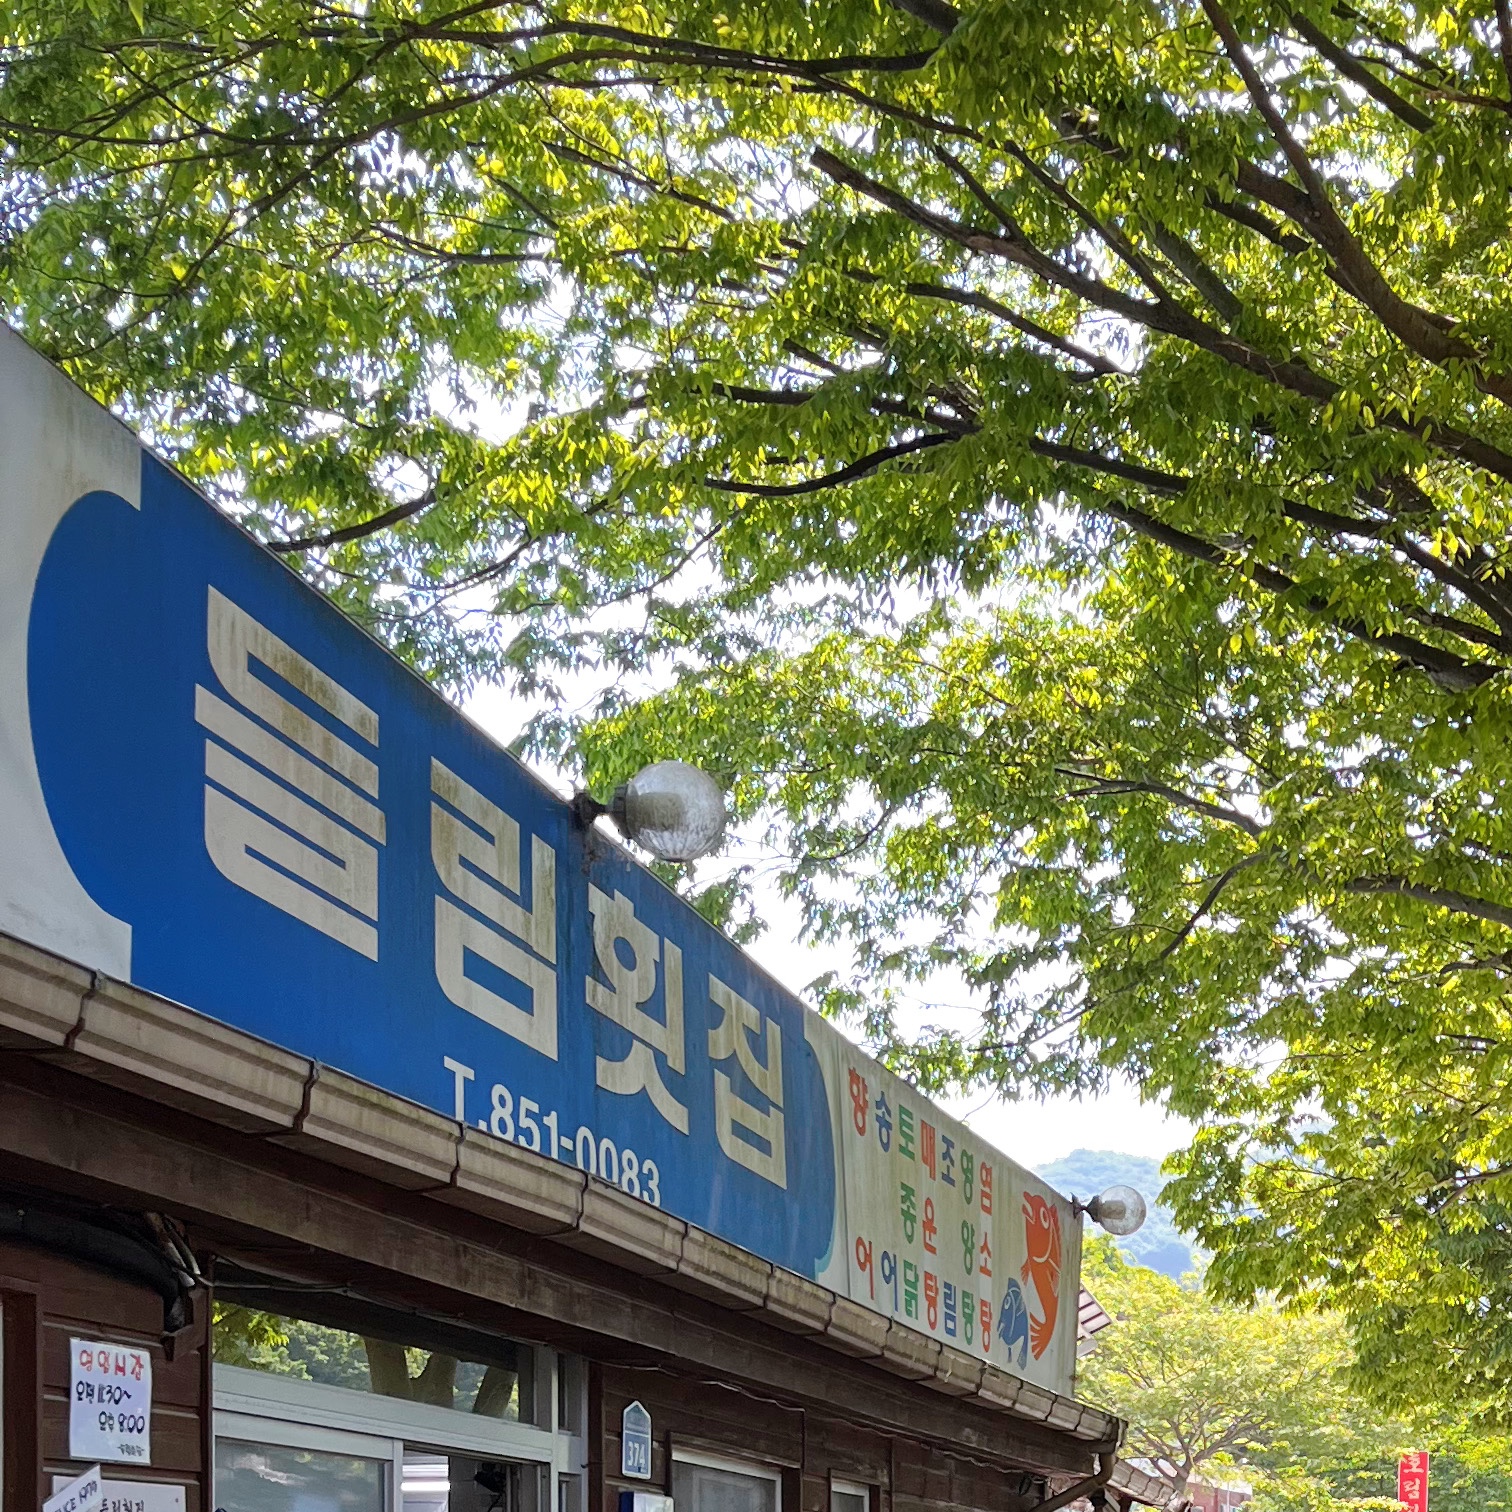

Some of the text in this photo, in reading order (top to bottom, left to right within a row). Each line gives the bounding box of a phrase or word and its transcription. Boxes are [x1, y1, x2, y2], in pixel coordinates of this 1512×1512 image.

[195, 583, 788, 1190] 들림횟집
[443, 1055, 661, 1208] T.851-0083
[849, 1066, 875, 1301] 향어
[874, 1090, 898, 1312] 송어
[898, 1103, 919, 1321] 토종닭
[920, 1119, 939, 1331] 매운탕
[941, 1134, 957, 1338] 조림
[960, 1148, 976, 1346] 영양탕
[979, 1160, 994, 1354] 염소탕
[628, 1441, 646, 1468] 374
